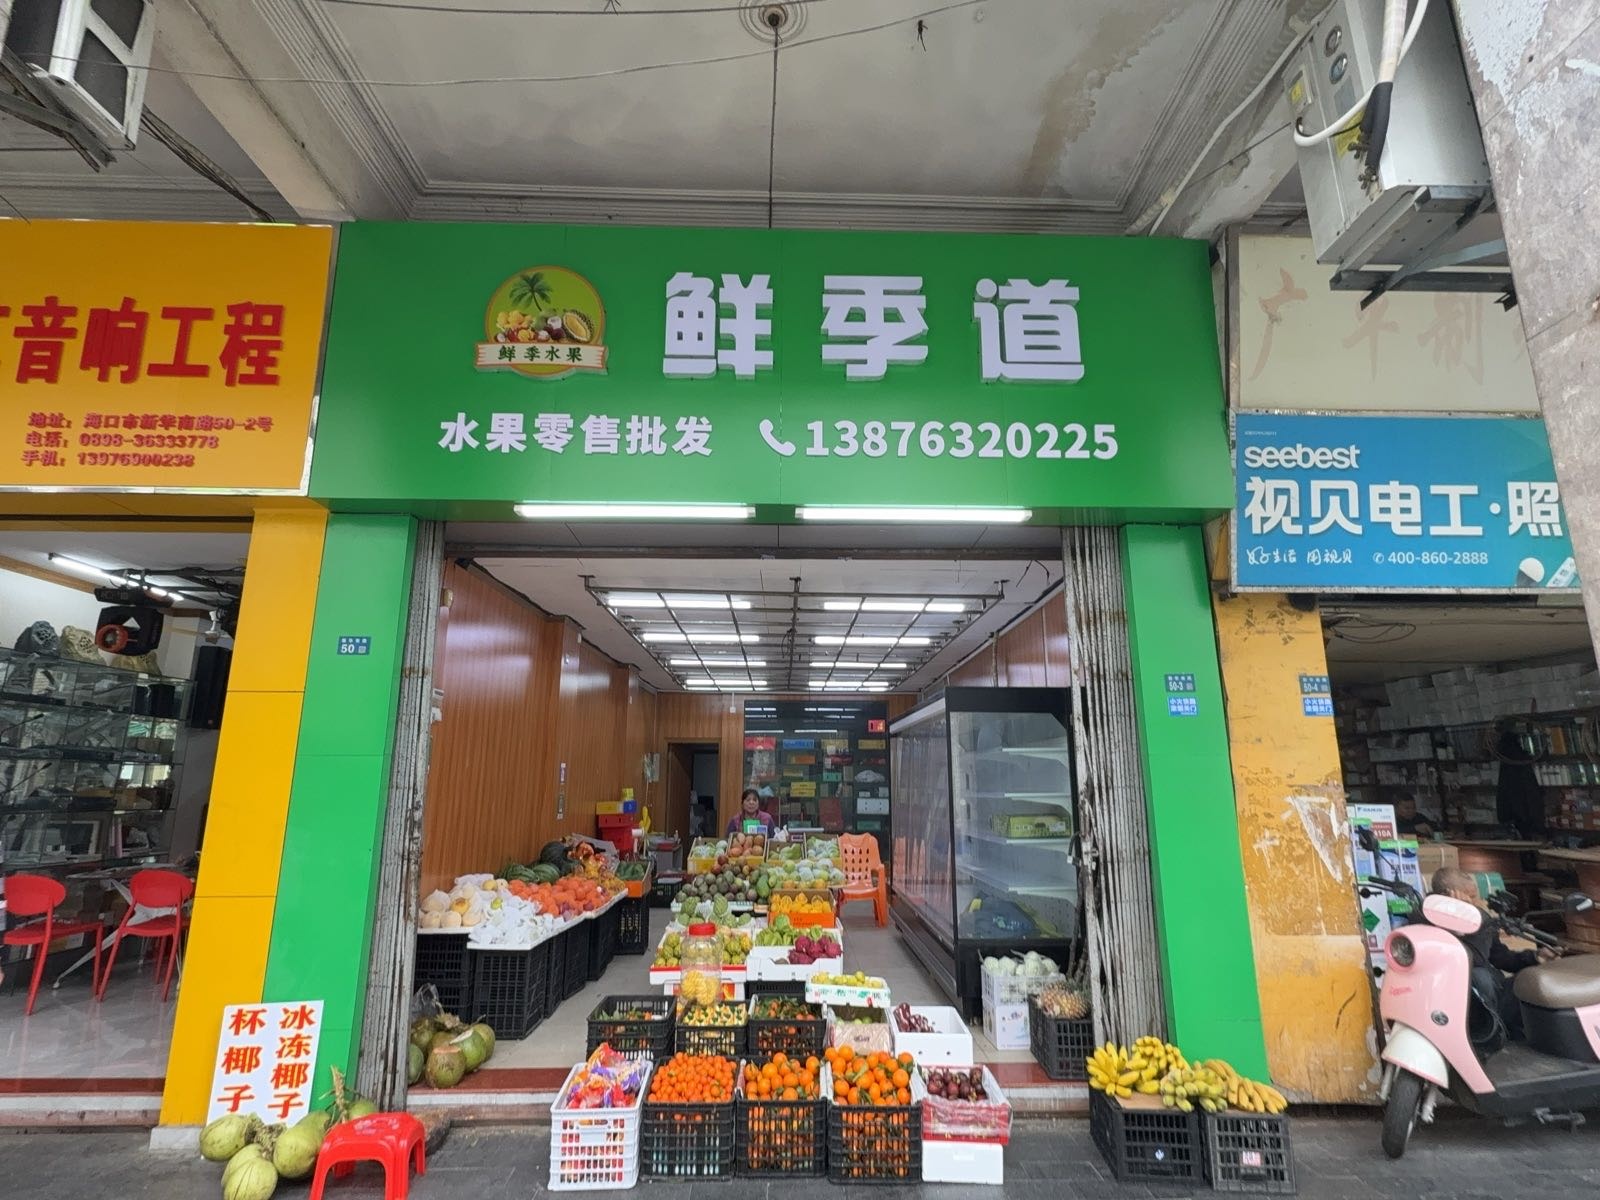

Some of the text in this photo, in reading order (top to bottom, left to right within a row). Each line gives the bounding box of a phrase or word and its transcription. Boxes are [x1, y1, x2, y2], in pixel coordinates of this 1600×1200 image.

[0, 296, 285, 387] 音响工程
[662, 271, 1085, 383] 鲜季道
[498, 345, 582, 362] 鲜季水果
[438, 412, 1120, 461] 水果零售批发 13876320225
[1243, 443, 1361, 470] seebest
[1387, 551, 1489, 566] 400-860-2888
[340, 644, 355, 654] 50
[217, 1007, 268, 1113] 杯椰子
[267, 1004, 316, 1119] 冰冻椰子
